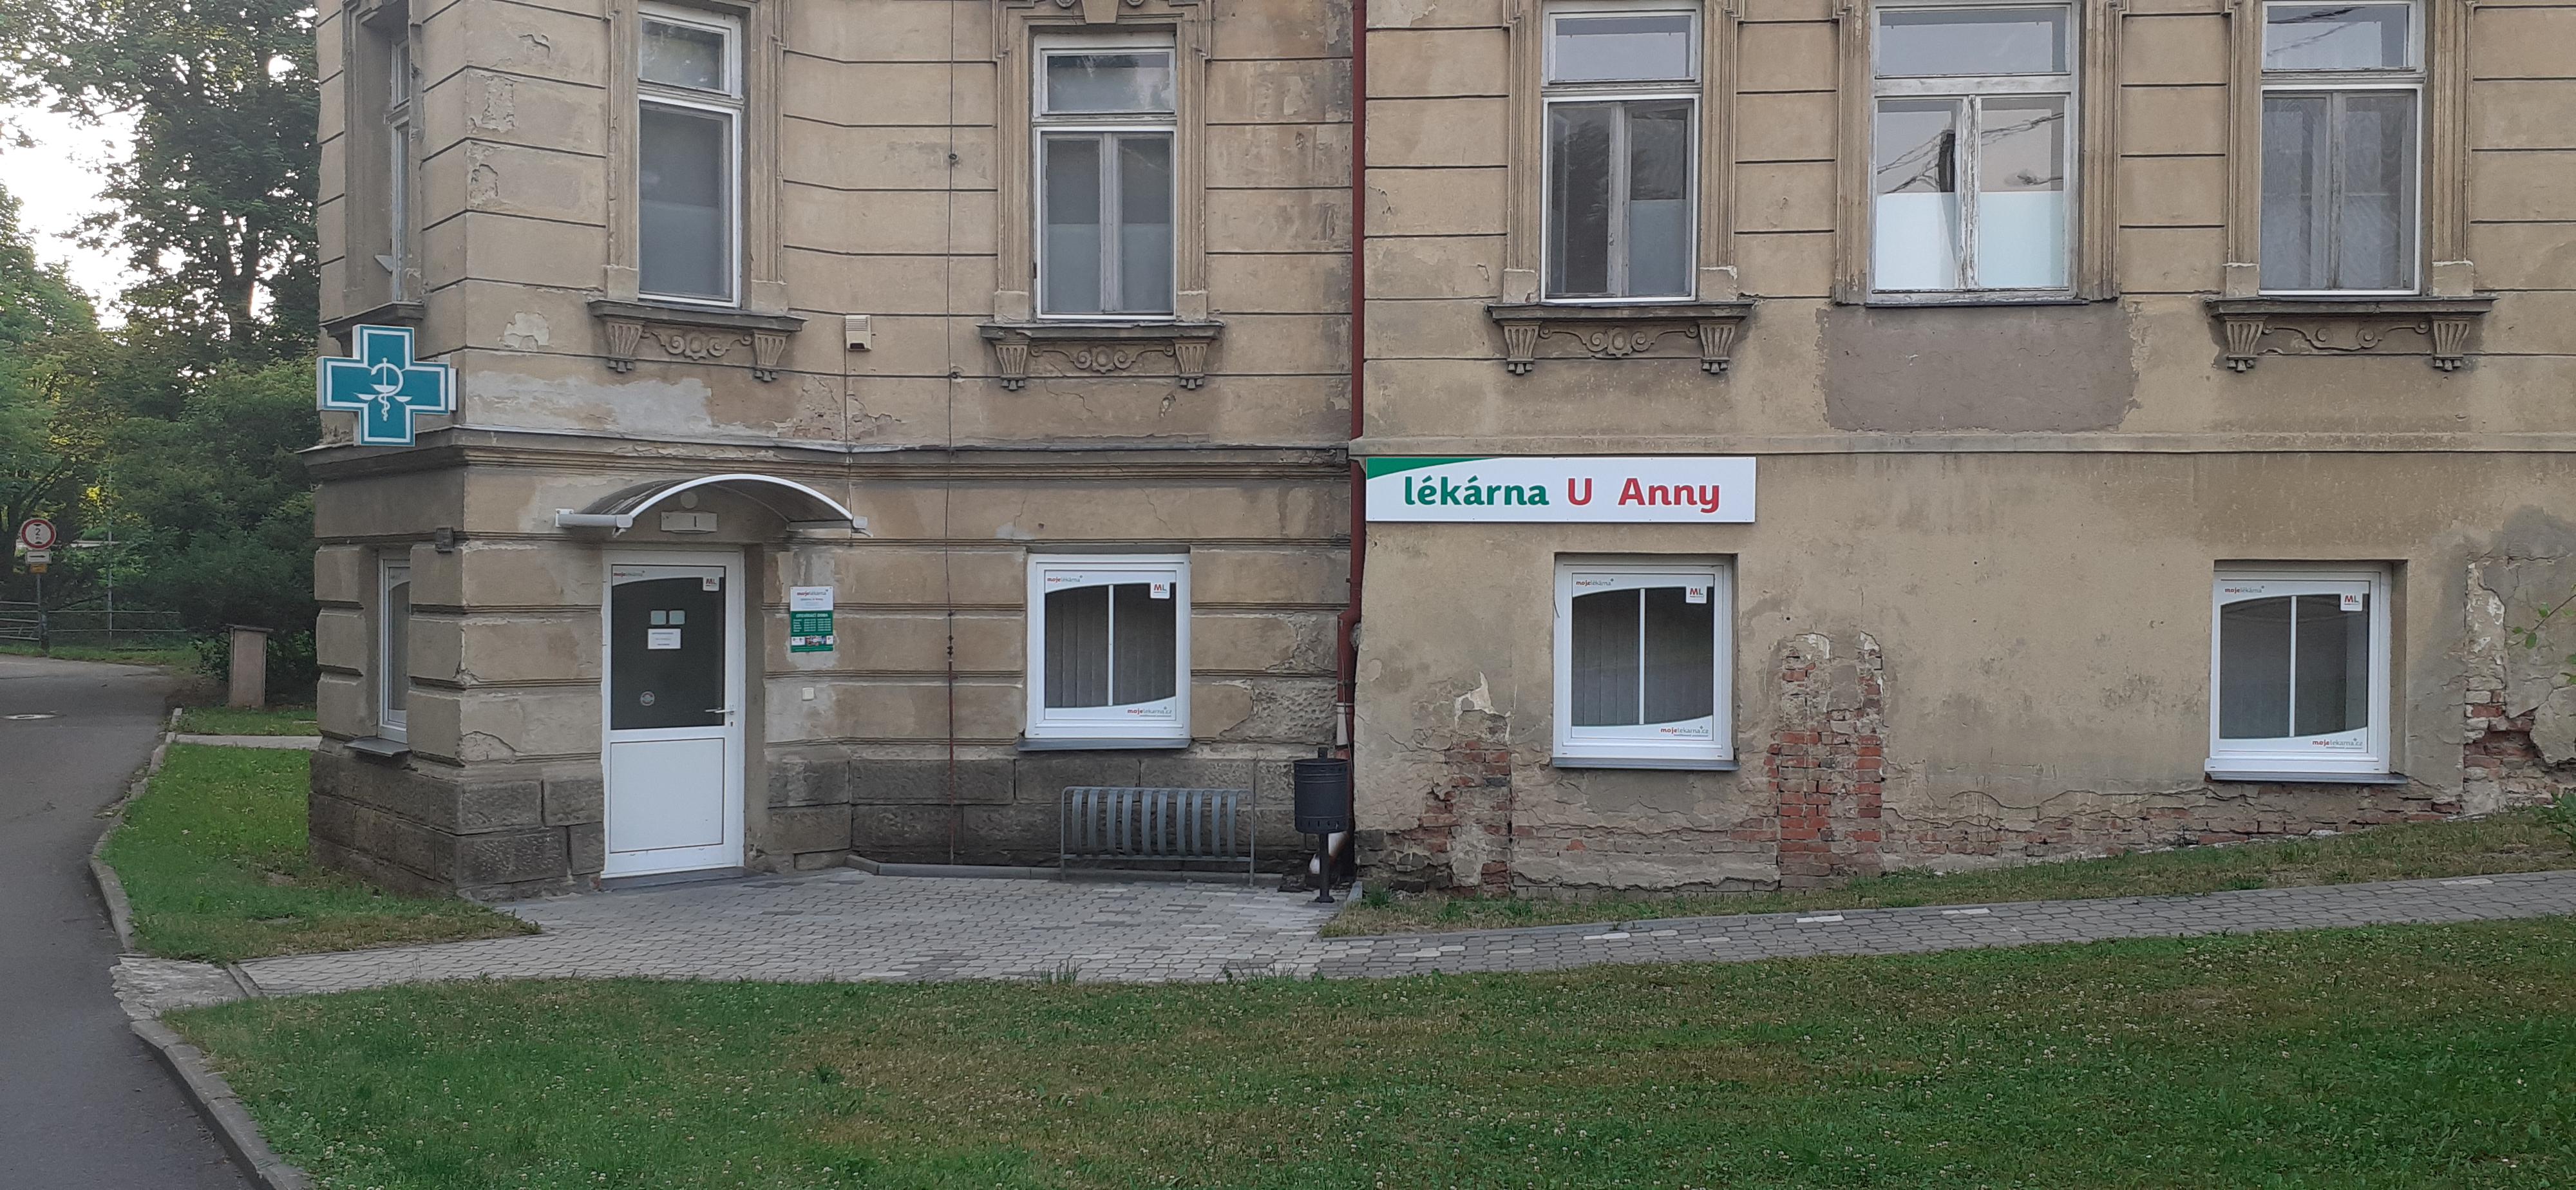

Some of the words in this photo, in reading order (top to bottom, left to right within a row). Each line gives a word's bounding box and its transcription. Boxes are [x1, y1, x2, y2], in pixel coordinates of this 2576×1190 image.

[1405, 475, 1549, 505] lékárna
[1567, 478, 1592, 505] U
[1618, 478, 1720, 514] Anny
